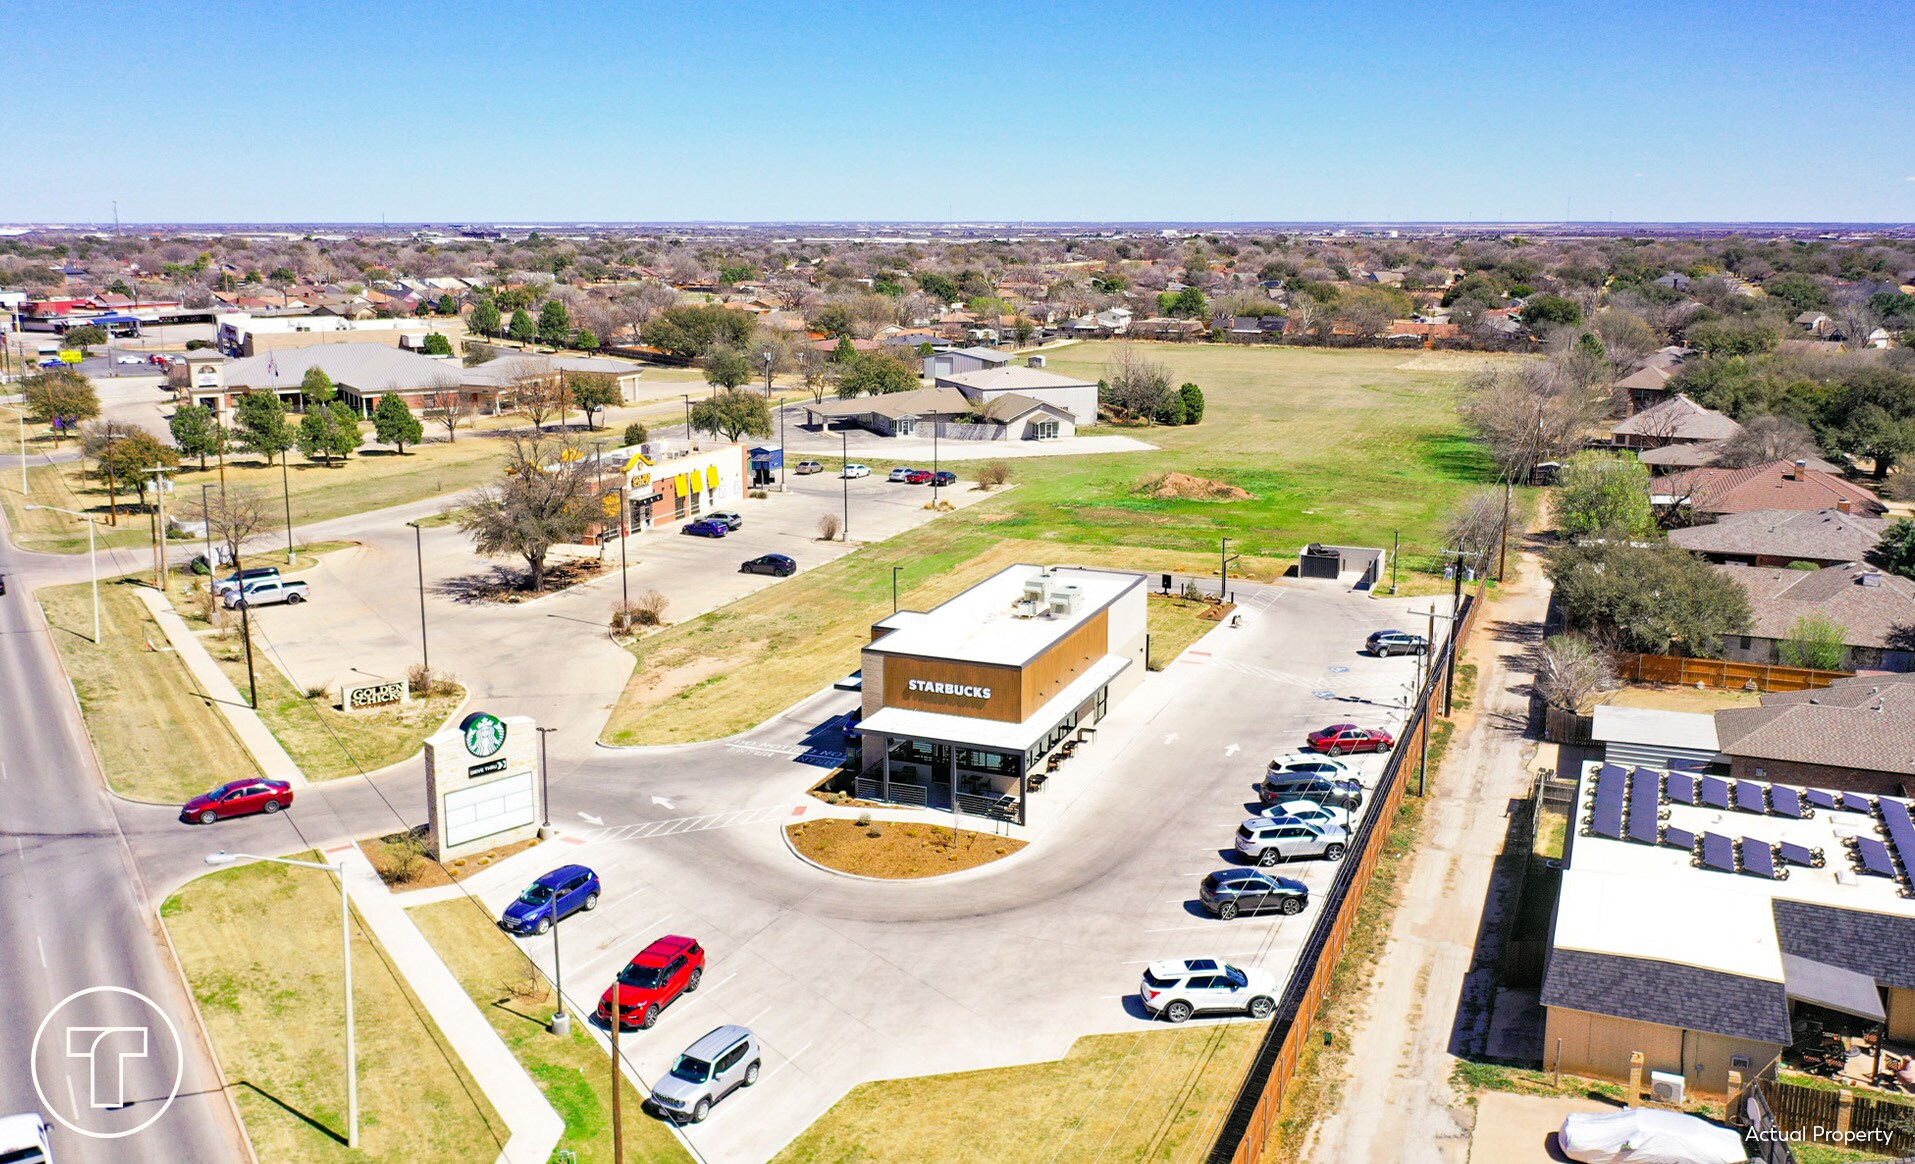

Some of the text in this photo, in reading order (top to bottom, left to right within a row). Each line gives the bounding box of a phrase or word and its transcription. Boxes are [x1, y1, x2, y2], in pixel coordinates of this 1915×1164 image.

[352, 683, 404, 700] GOLDEN
[908, 679, 991, 699] STARBUCKS
[358, 692, 401, 706] CHICK
[470, 763, 498, 776] DRIVE THRU
